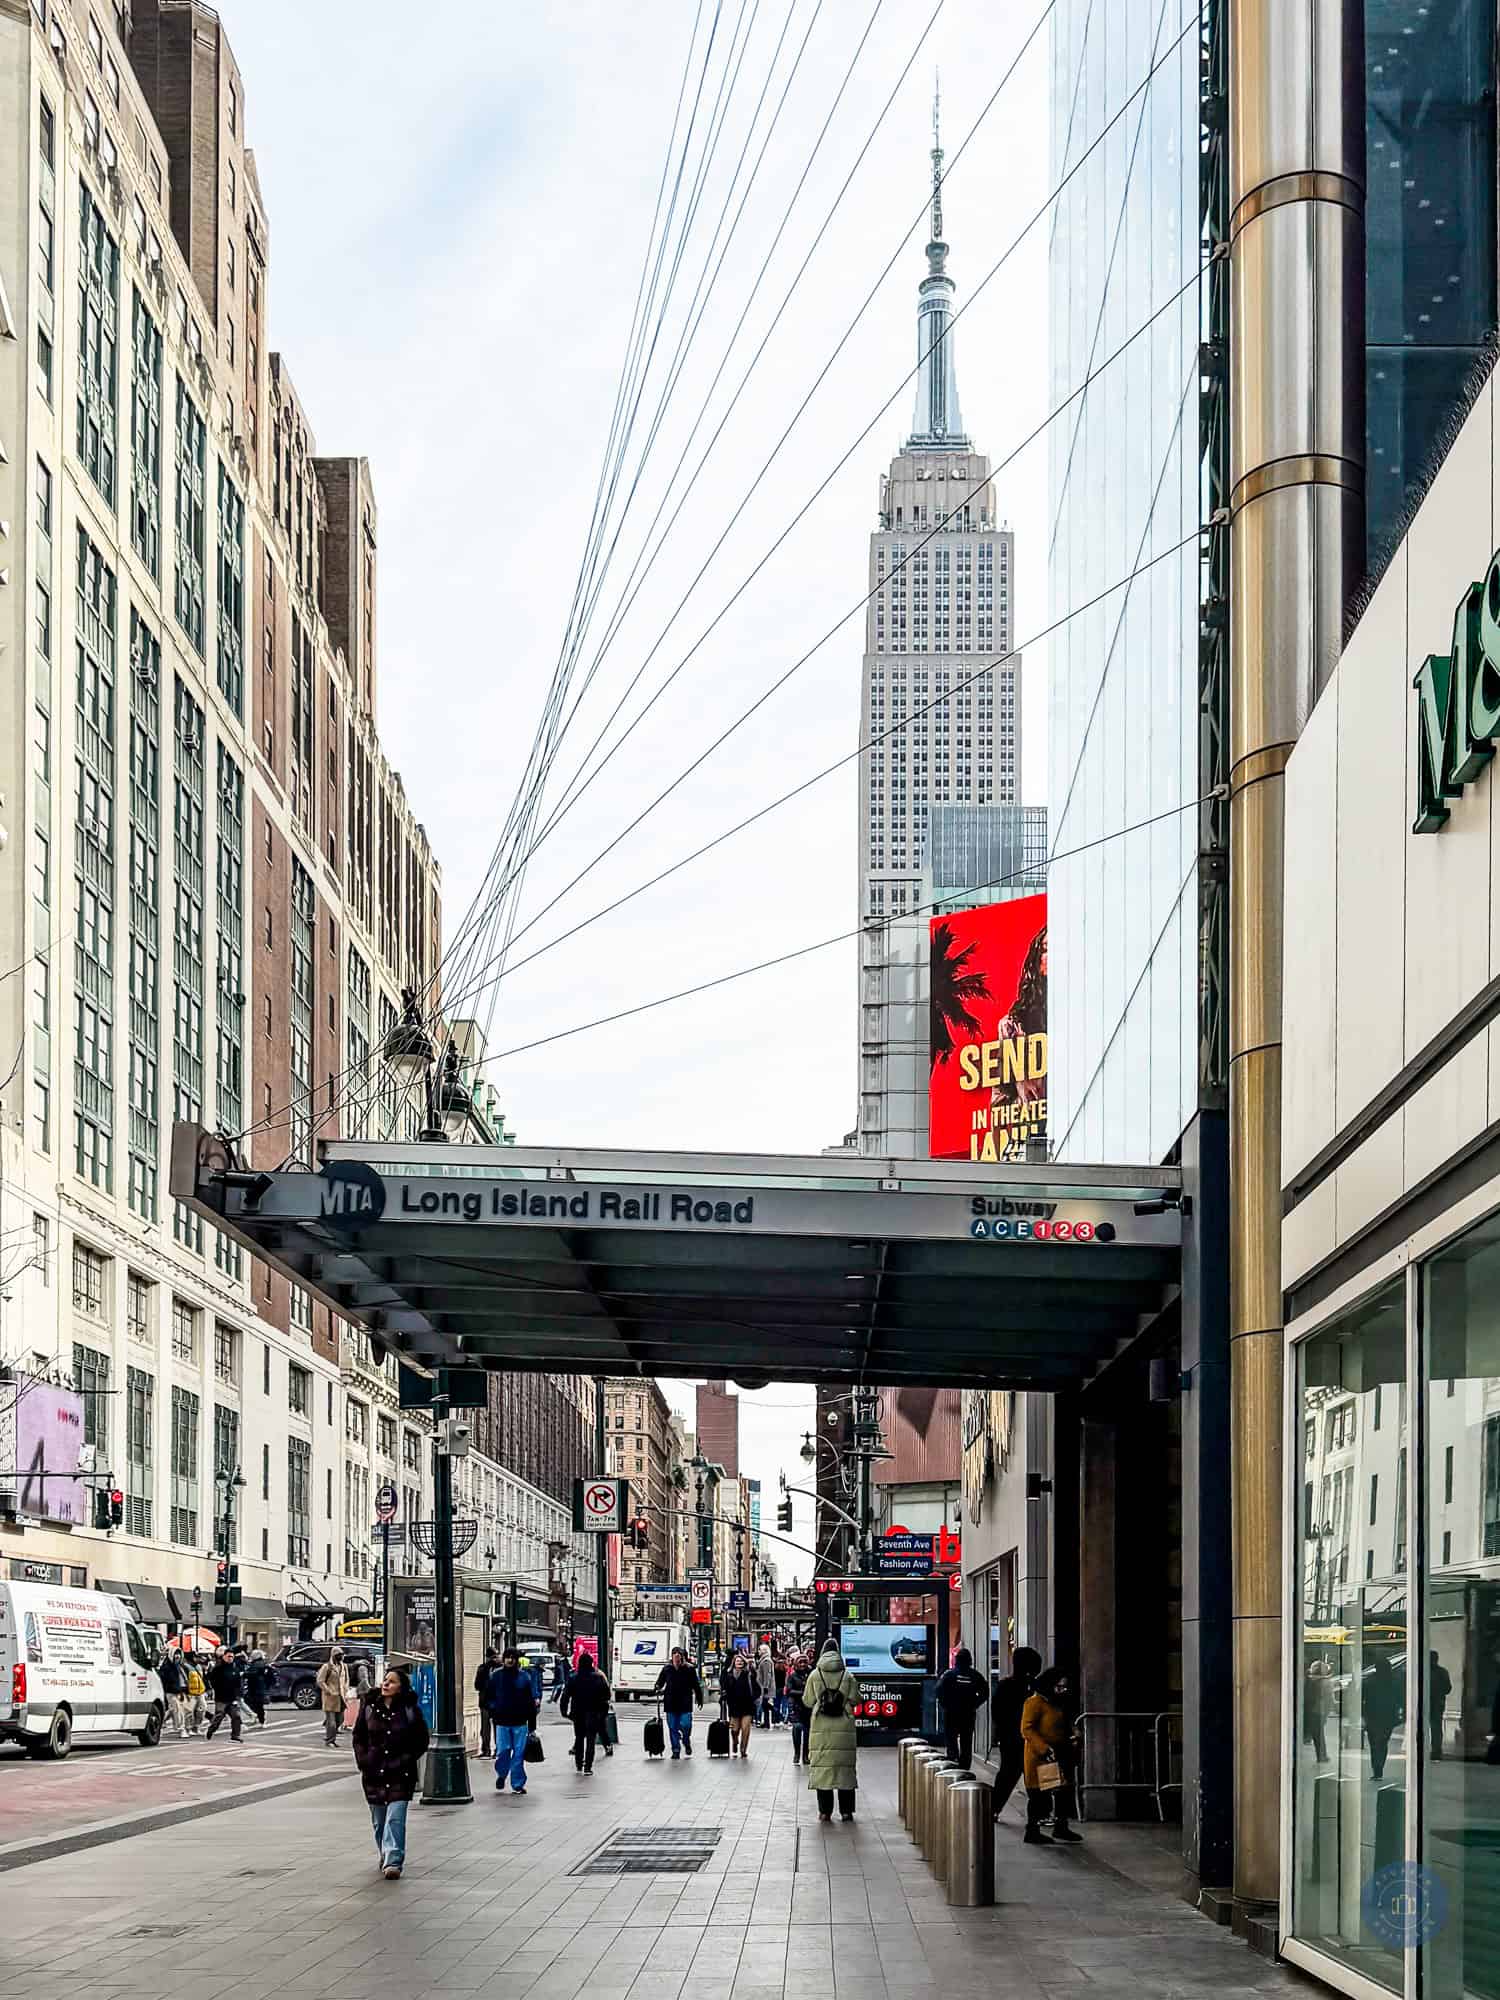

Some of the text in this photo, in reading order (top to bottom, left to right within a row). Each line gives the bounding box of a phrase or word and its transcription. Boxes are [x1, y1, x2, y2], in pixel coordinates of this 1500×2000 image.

[959, 1033, 1047, 1091] SEND
[972, 1108, 987, 1130] IN
[321, 1179, 373, 1216] MTA
[402, 1184, 754, 1223] Long Island Rail Road
[971, 1196, 1057, 1220] Subway
[878, 1540, 930, 1549] Seventh Ave
[879, 1560, 929, 1569] Fashion Ave
[859, 1683, 886, 1692] Street
[871, 1692, 902, 1701] Station
